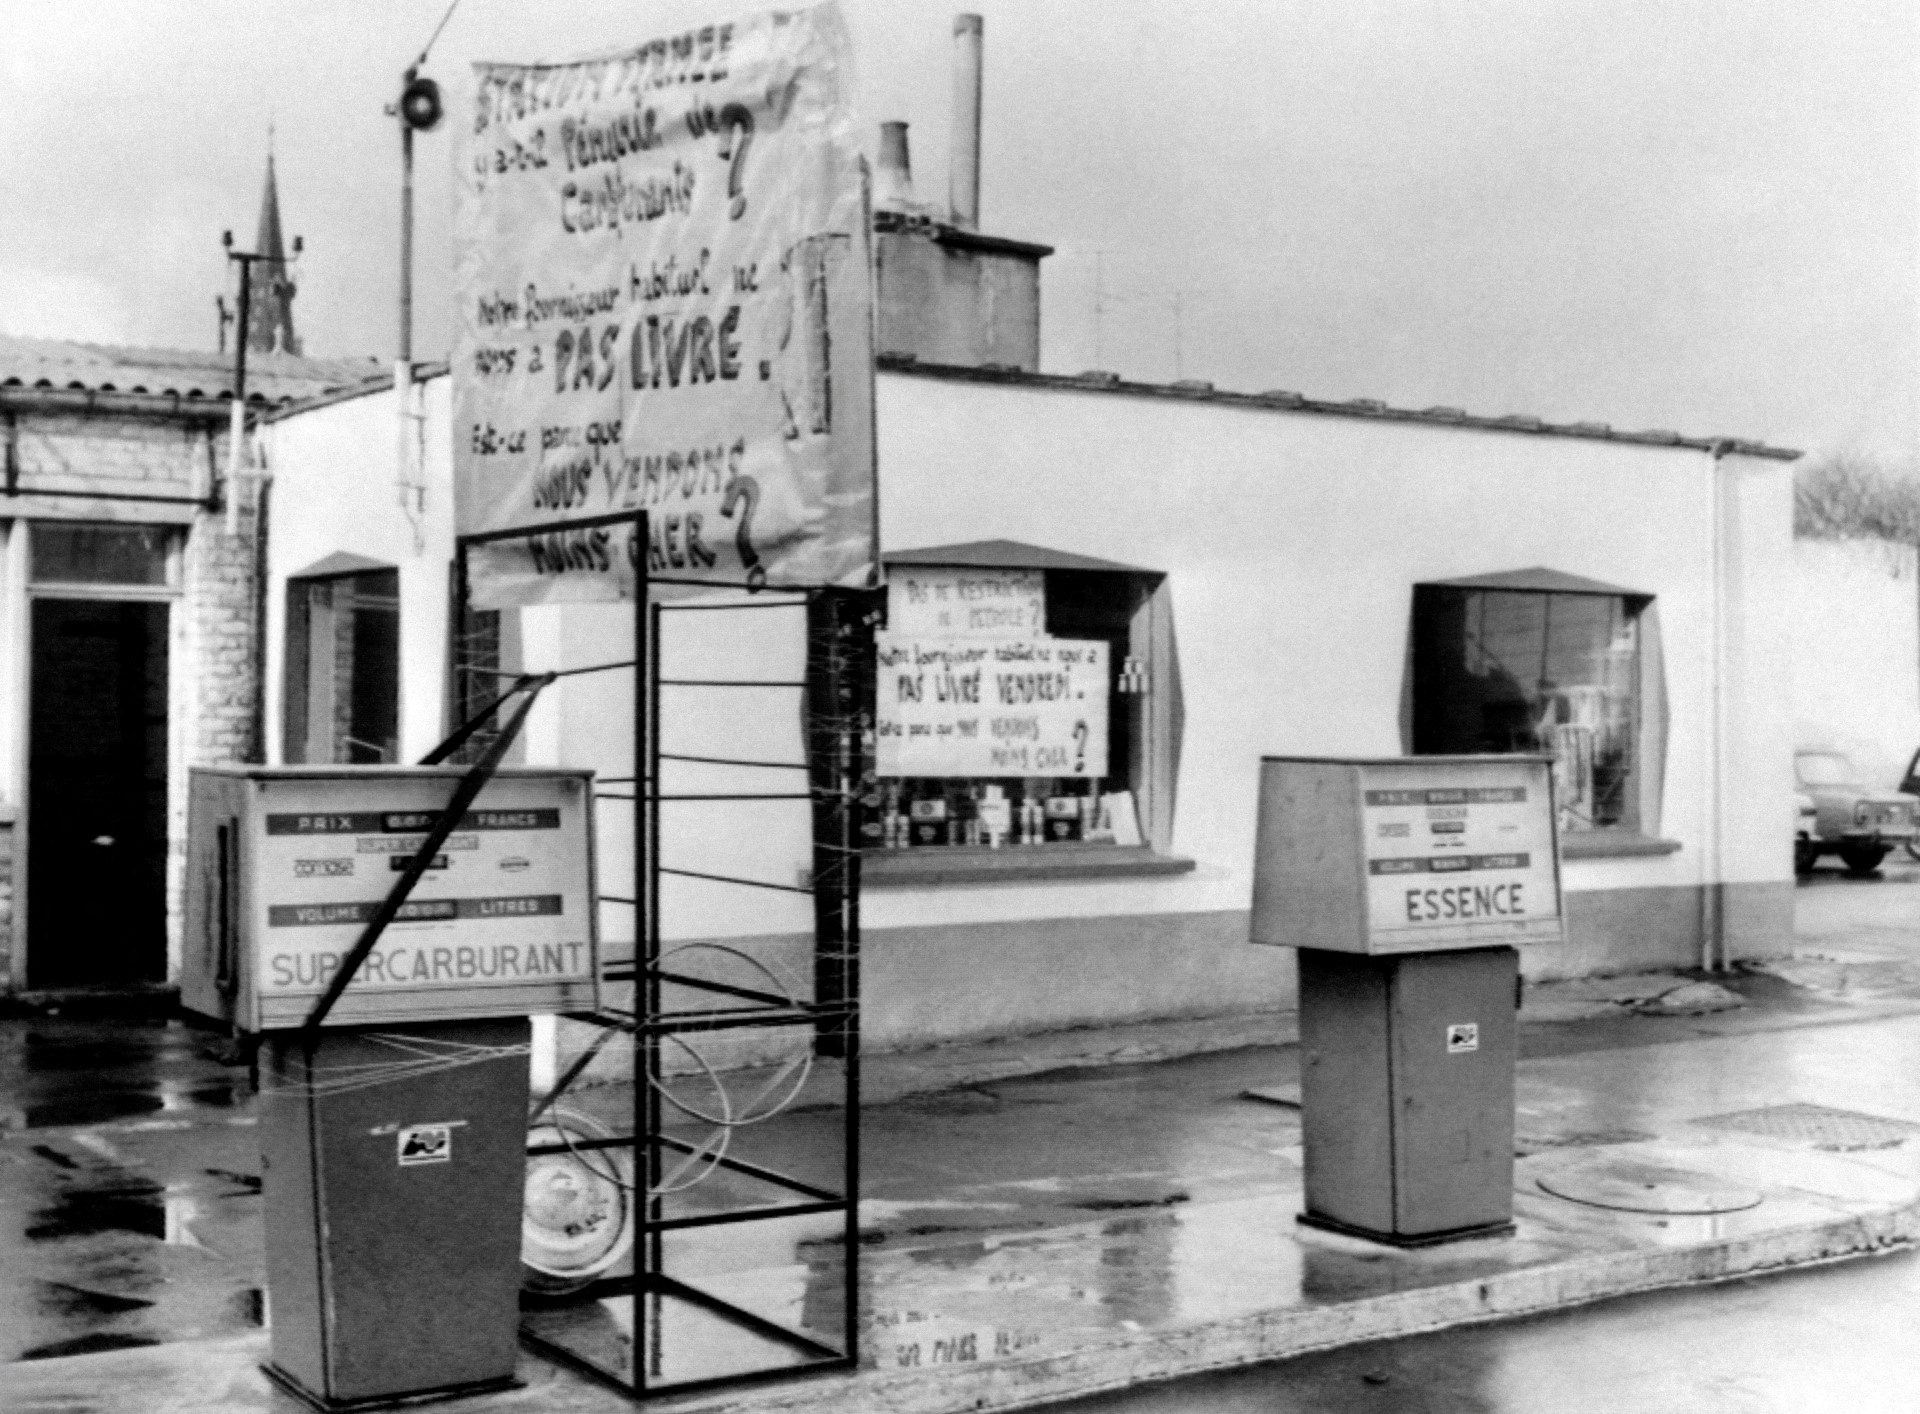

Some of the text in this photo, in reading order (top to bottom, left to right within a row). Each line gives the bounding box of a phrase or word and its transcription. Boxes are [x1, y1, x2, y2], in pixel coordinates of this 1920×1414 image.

[718, 102, 756, 221] ?
[554, 324, 620, 393] PAS
[719, 474, 768, 595] ?
[898, 672, 925, 705] PAS
[1071, 717, 1092, 774] ?
[298, 817, 352, 831] PRIX
[296, 899, 539, 923] VOLUME LITRES
[1405, 883, 1526, 922] ESSENCE
[270, 941, 586, 988] SUPRCARBURANT
